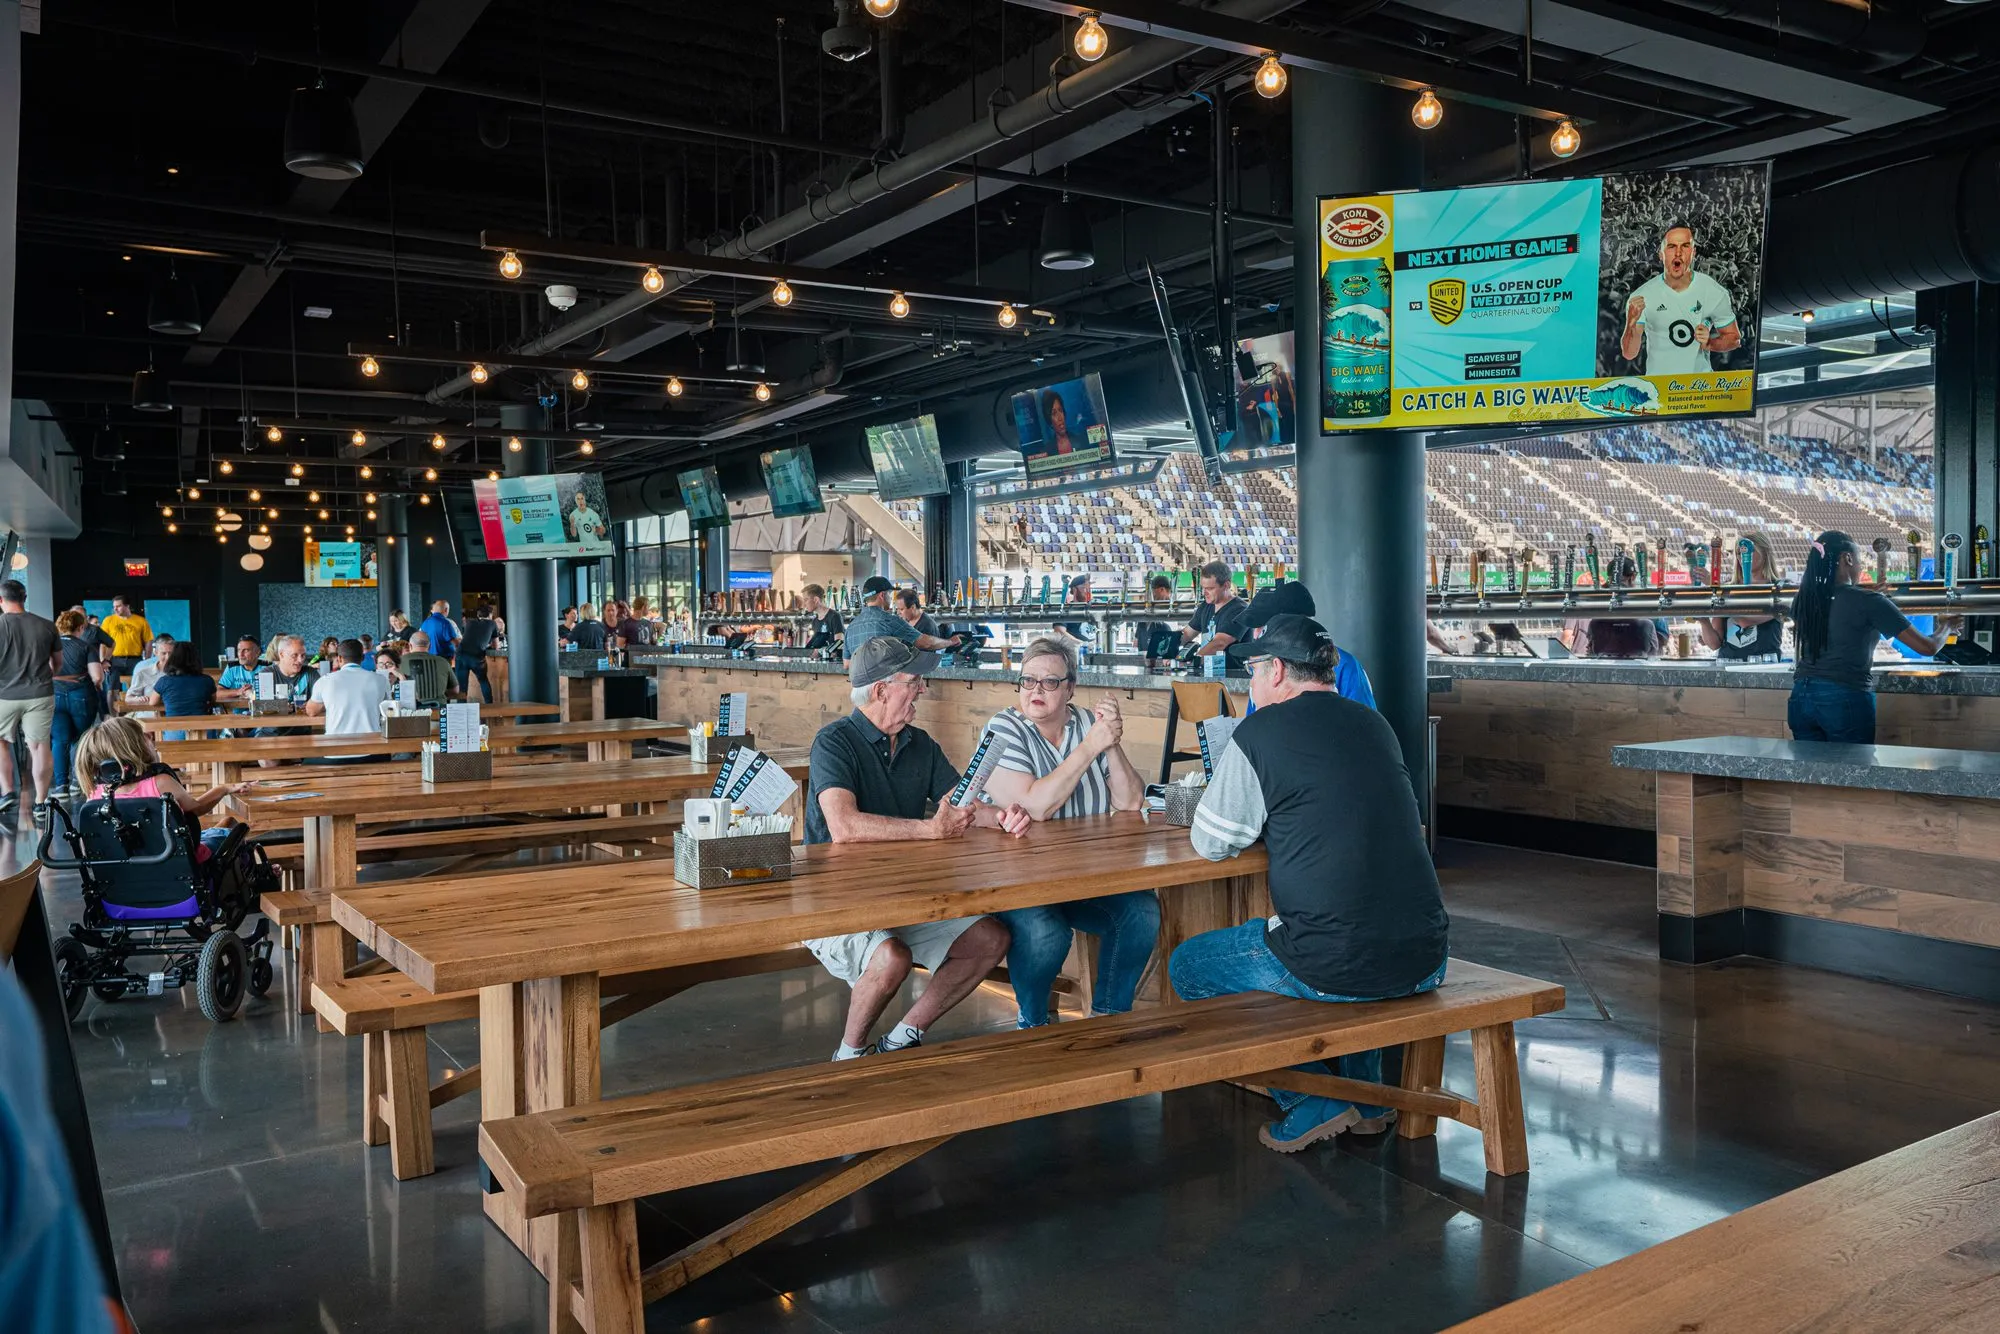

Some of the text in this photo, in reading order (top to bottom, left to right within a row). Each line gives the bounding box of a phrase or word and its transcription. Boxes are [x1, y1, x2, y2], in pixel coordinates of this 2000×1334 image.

[1342, 209, 1368, 220] KONA
[1333, 233, 1369, 245] BREWING
[1408, 251, 1458, 267] NEXT
[1460, 245, 1512, 262] HOME
[1434, 287, 1459, 297] UNITED
[1471, 278, 1562, 294] U.S. OPEN CUP
[1472, 290, 1573, 307] WED 07.10 7 PM
[1471, 305, 1560, 319] QUARTERFINAL ROUND
[1467, 353, 1519, 364] SCARVES UP
[1331, 364, 1385, 377] BIG WAVE
[1468, 368, 1517, 378] MINNESOTA
[1668, 379, 1685, 391] One
[1715, 375, 1751, 392] Right?
[1402, 385, 1591, 411] CATCH A BIG WAVE
[1667, 394, 1692, 402] Balanced
[1703, 392, 1733, 402] refreshing
[1353, 399, 1365, 410] 16
[1667, 403, 1689, 411] tropical
[1508, 407, 1552, 420] Golden
[1200, 739, 1211, 769] BREW
[713, 762, 732, 797] BREW
[950, 747, 986, 802] BREW HALL
[730, 769, 755, 800] BREW
